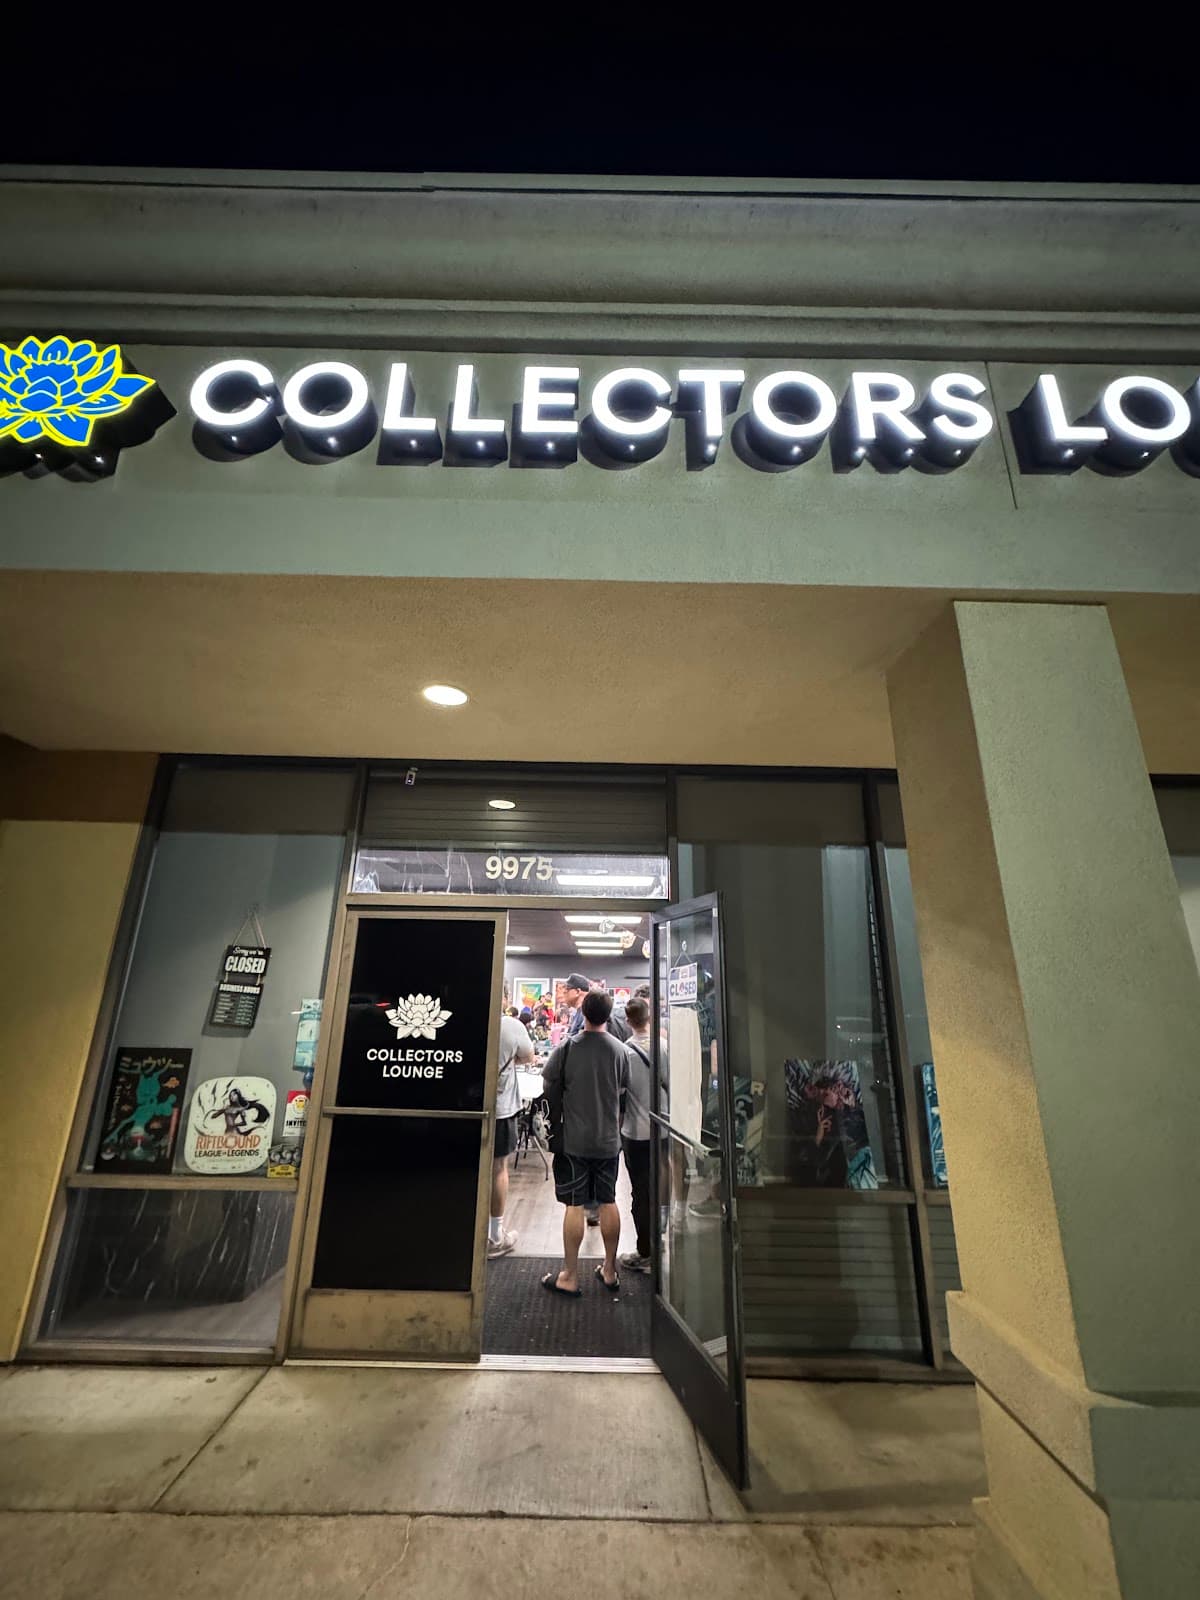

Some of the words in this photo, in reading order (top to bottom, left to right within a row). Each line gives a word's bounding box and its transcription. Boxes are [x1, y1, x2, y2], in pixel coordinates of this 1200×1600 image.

[190, 359, 994, 440] COLLECTORS
[1038, 374, 1200, 442] LO
[485, 855, 553, 880] 9975
[225, 955, 266, 974] CLOSED
[670, 981, 696, 997] CLOSED
[366, 1048, 464, 1063] COLLECTORS
[119, 1056, 185, 1074] ミュウツー
[382, 1065, 444, 1079] LOUNGE
[196, 1134, 261, 1149] RIFTBOUND
[195, 1150, 223, 1158] LEAGUE
[227, 1149, 260, 1157] LEGENDS
